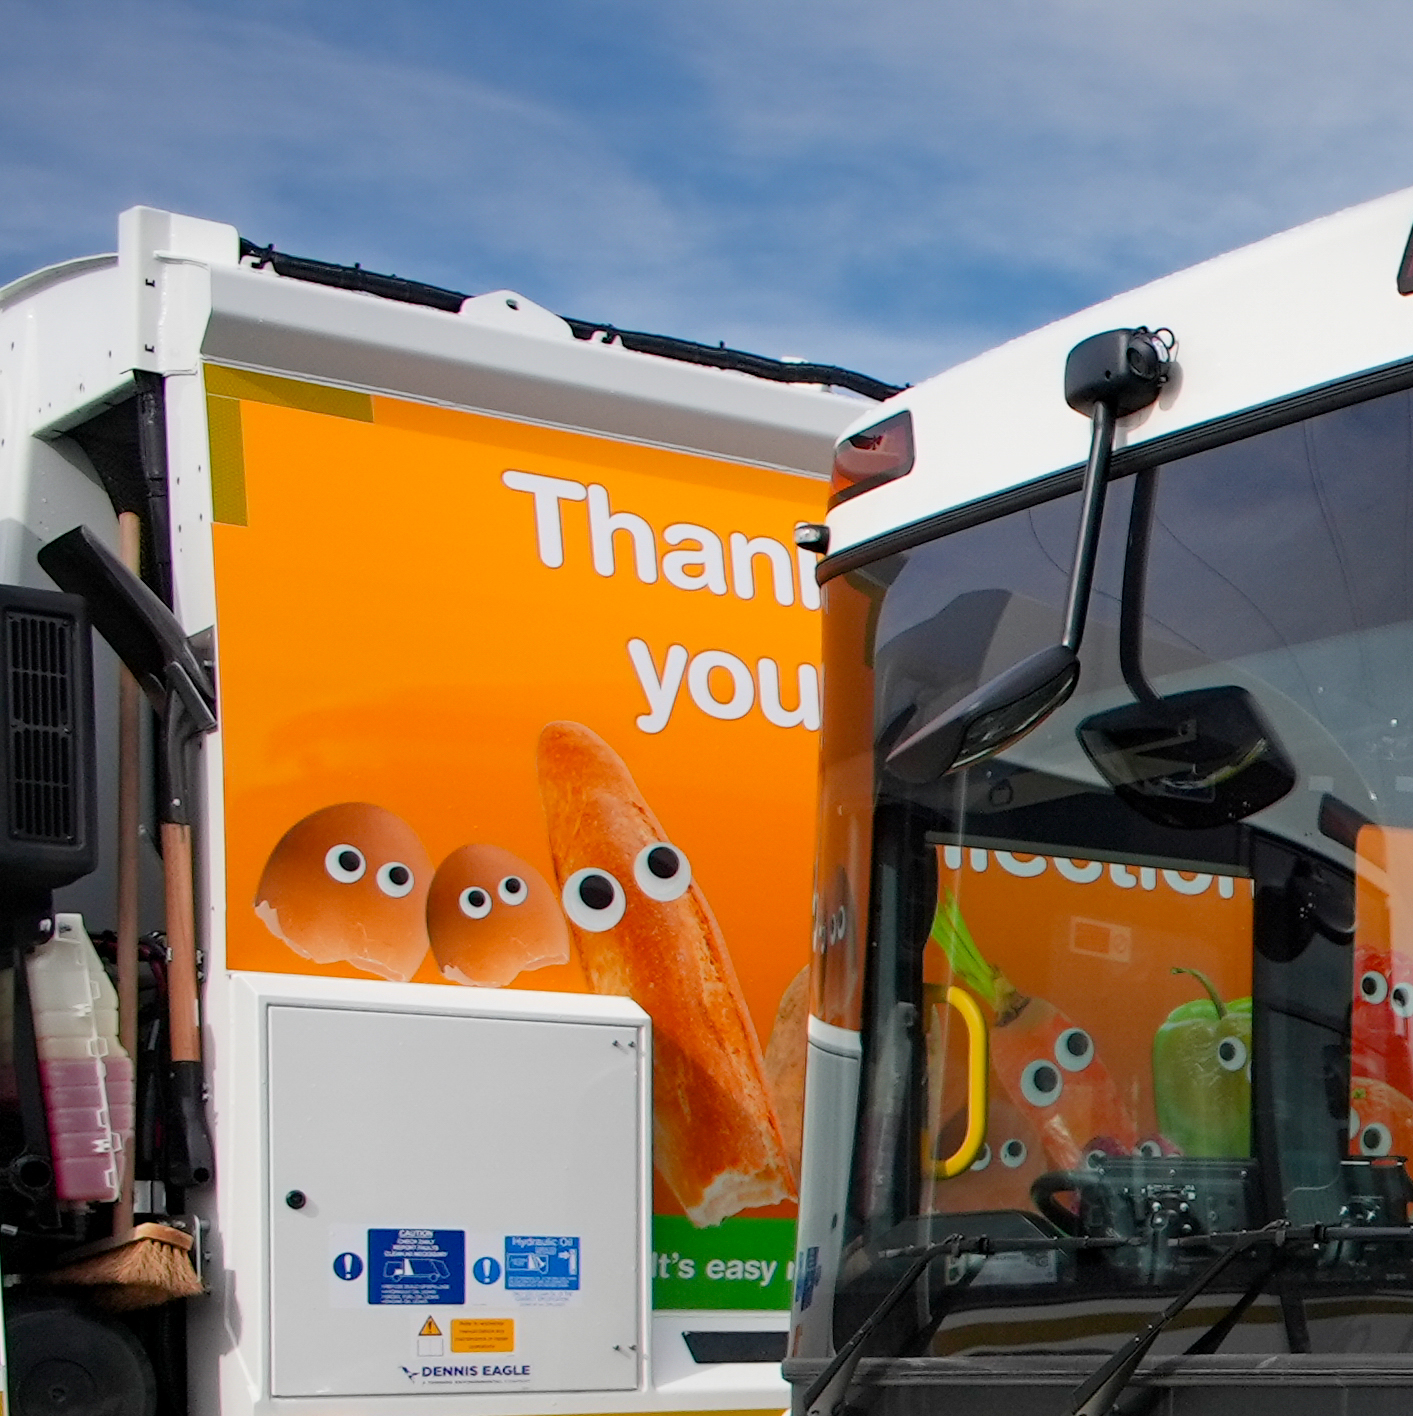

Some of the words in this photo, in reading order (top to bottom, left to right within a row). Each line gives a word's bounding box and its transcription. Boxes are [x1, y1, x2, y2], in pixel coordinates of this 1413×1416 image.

[706, 1258, 777, 1287] easy
[421, 1366, 478, 1377] DENNIS
[482, 1365, 530, 1376] EAGLE
